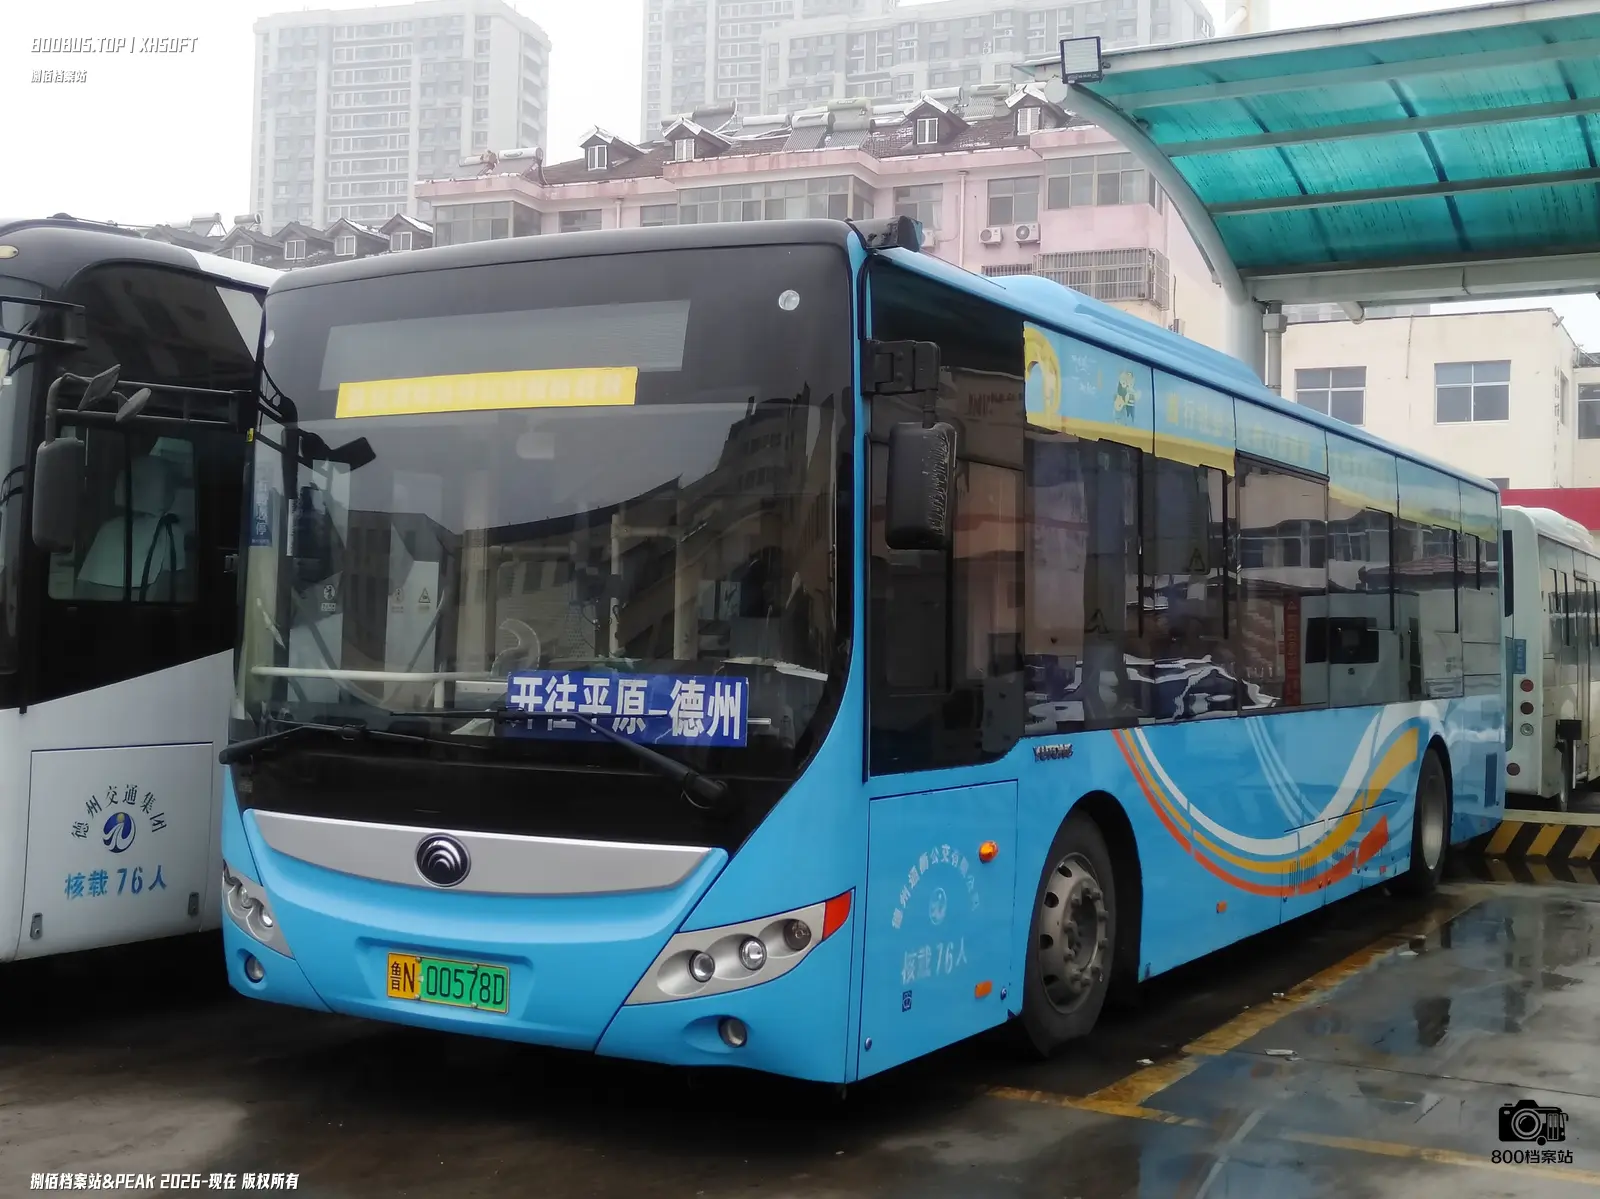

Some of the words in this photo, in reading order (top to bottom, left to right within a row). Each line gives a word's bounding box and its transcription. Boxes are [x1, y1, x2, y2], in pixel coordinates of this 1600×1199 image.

[71, 784, 167, 838] 德州交通集团
